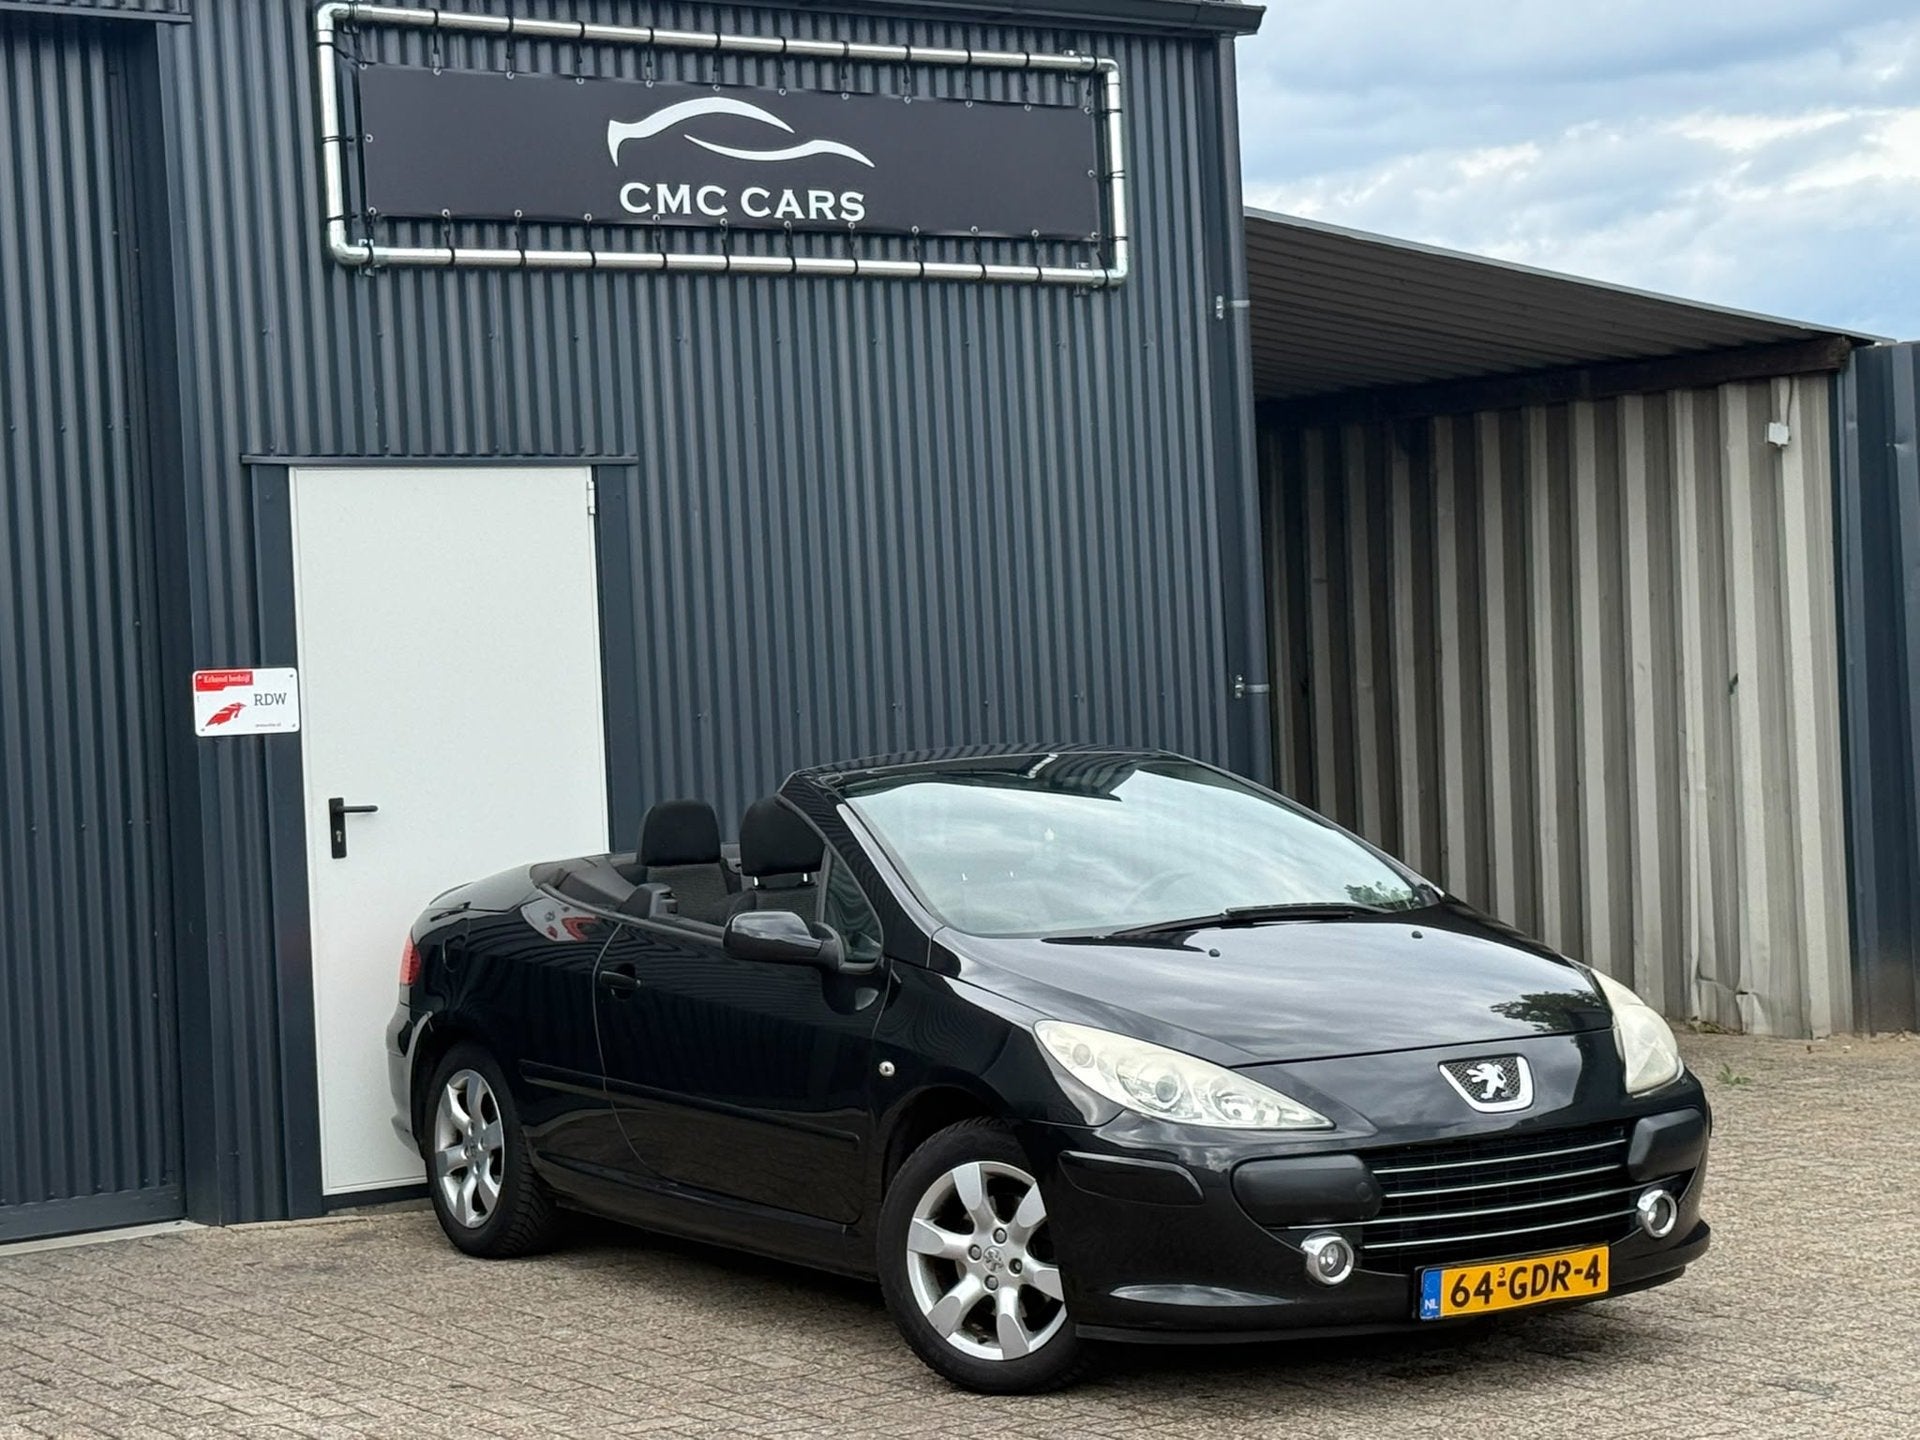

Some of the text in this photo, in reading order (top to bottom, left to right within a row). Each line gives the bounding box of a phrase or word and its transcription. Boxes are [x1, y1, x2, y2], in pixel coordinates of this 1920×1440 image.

[619, 182, 866, 222] CMC CARS
[253, 692, 287, 706] RDW
[1450, 1254, 1601, 1308] 64-GDR-4
[1424, 1298, 1439, 1310] NL
